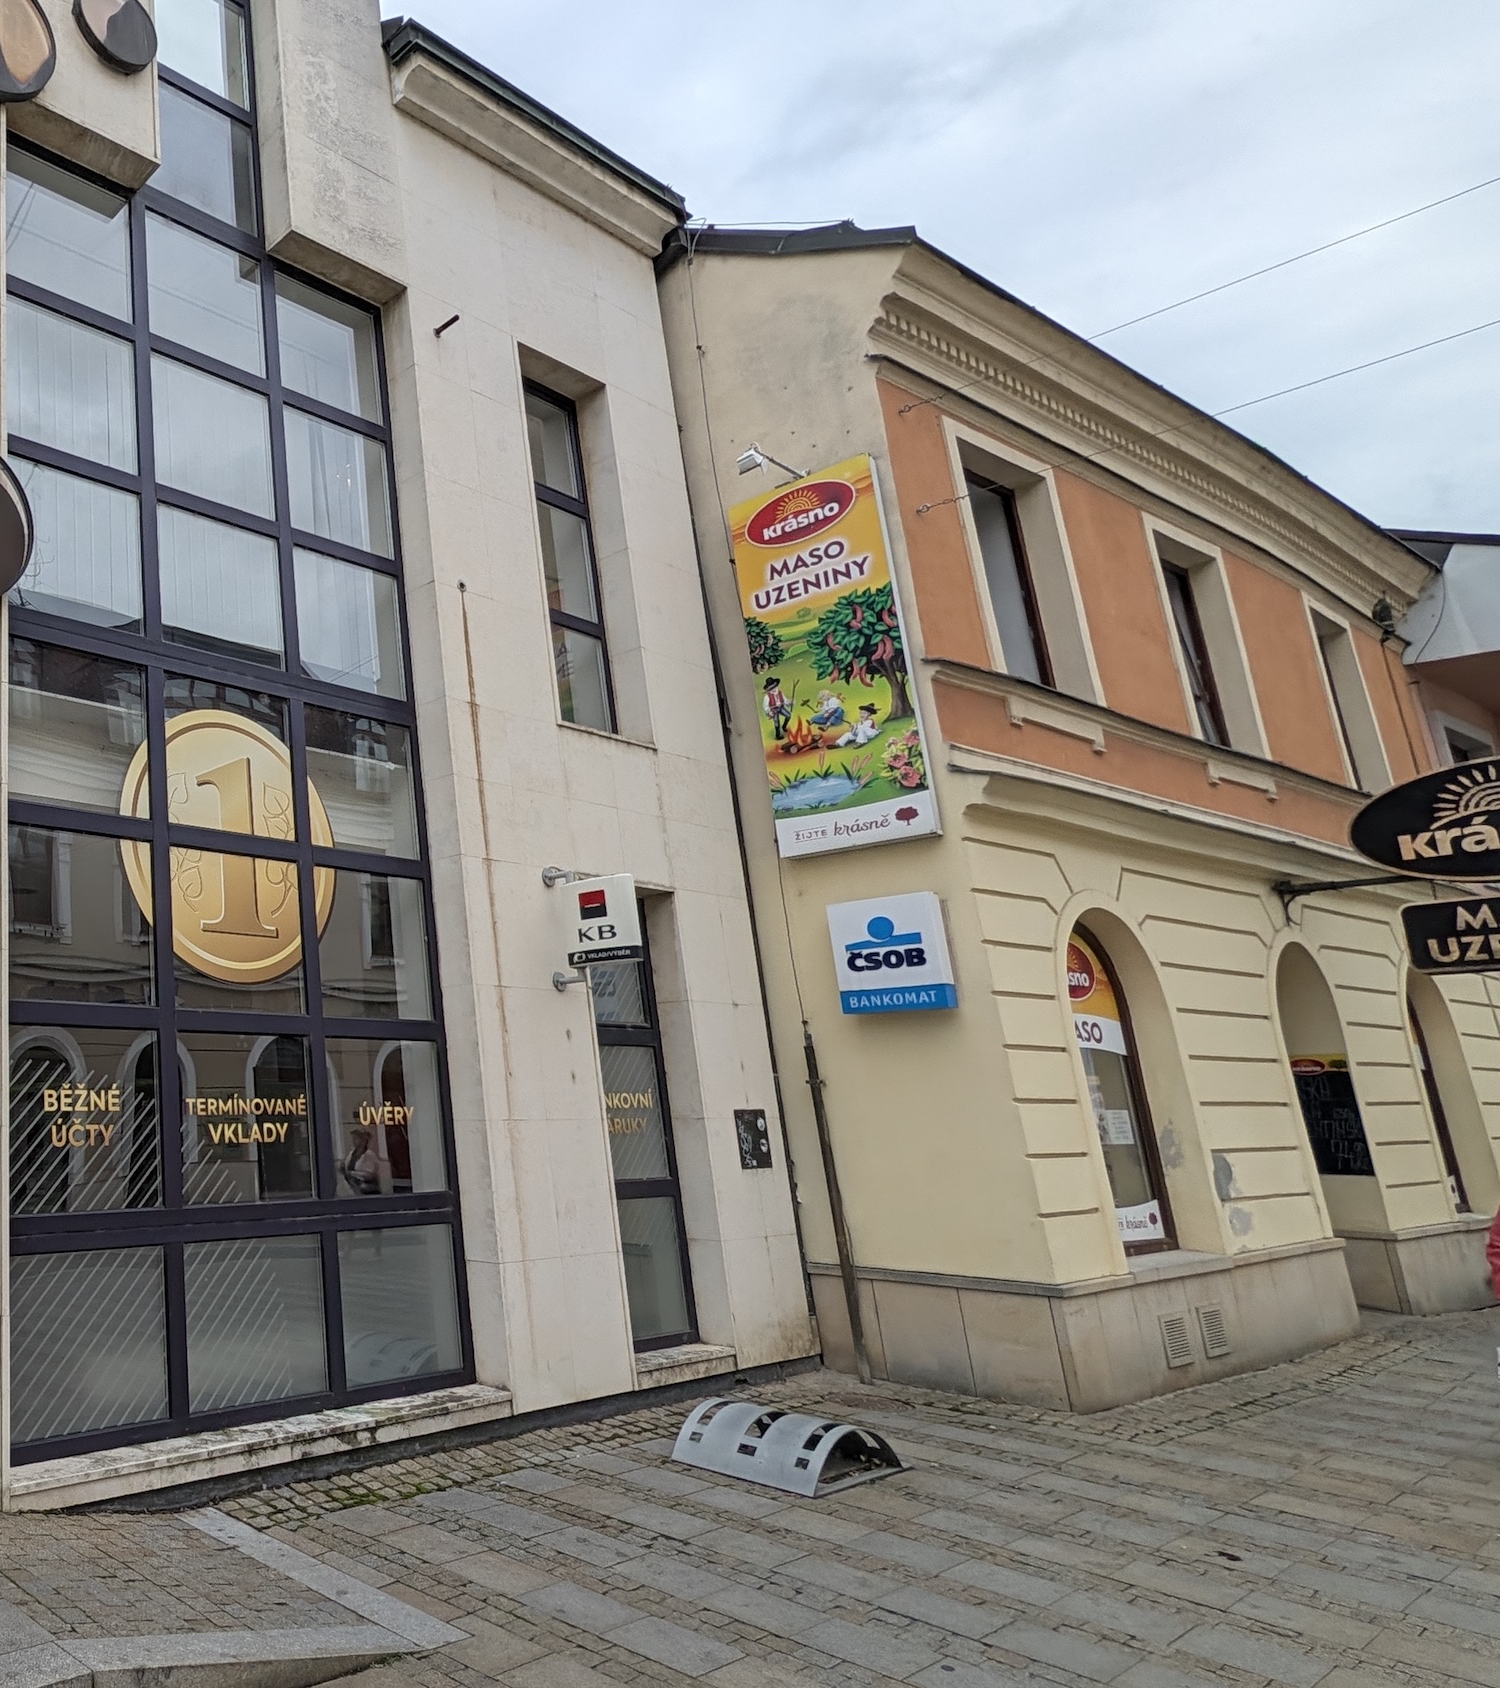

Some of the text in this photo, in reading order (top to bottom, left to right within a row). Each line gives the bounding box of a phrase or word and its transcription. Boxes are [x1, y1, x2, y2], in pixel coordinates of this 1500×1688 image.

[762, 502, 840, 541] krásno
[769, 540, 845, 581] MASO
[754, 555, 870, 609] UZENINY
[795, 813, 891, 841] ŽIJTE krásně
[577, 924, 617, 943] KB
[846, 947, 927, 972] ČSOB
[849, 990, 938, 1008] BANKOMAT
[43, 1082, 121, 1112] BĚŽNÉ
[185, 1093, 307, 1116] TERMÍNOVANÉ
[359, 1101, 414, 1126] ÚVĚRY
[51, 1118, 115, 1148] ÚČTY
[209, 1122, 289, 1144] VKLADY
